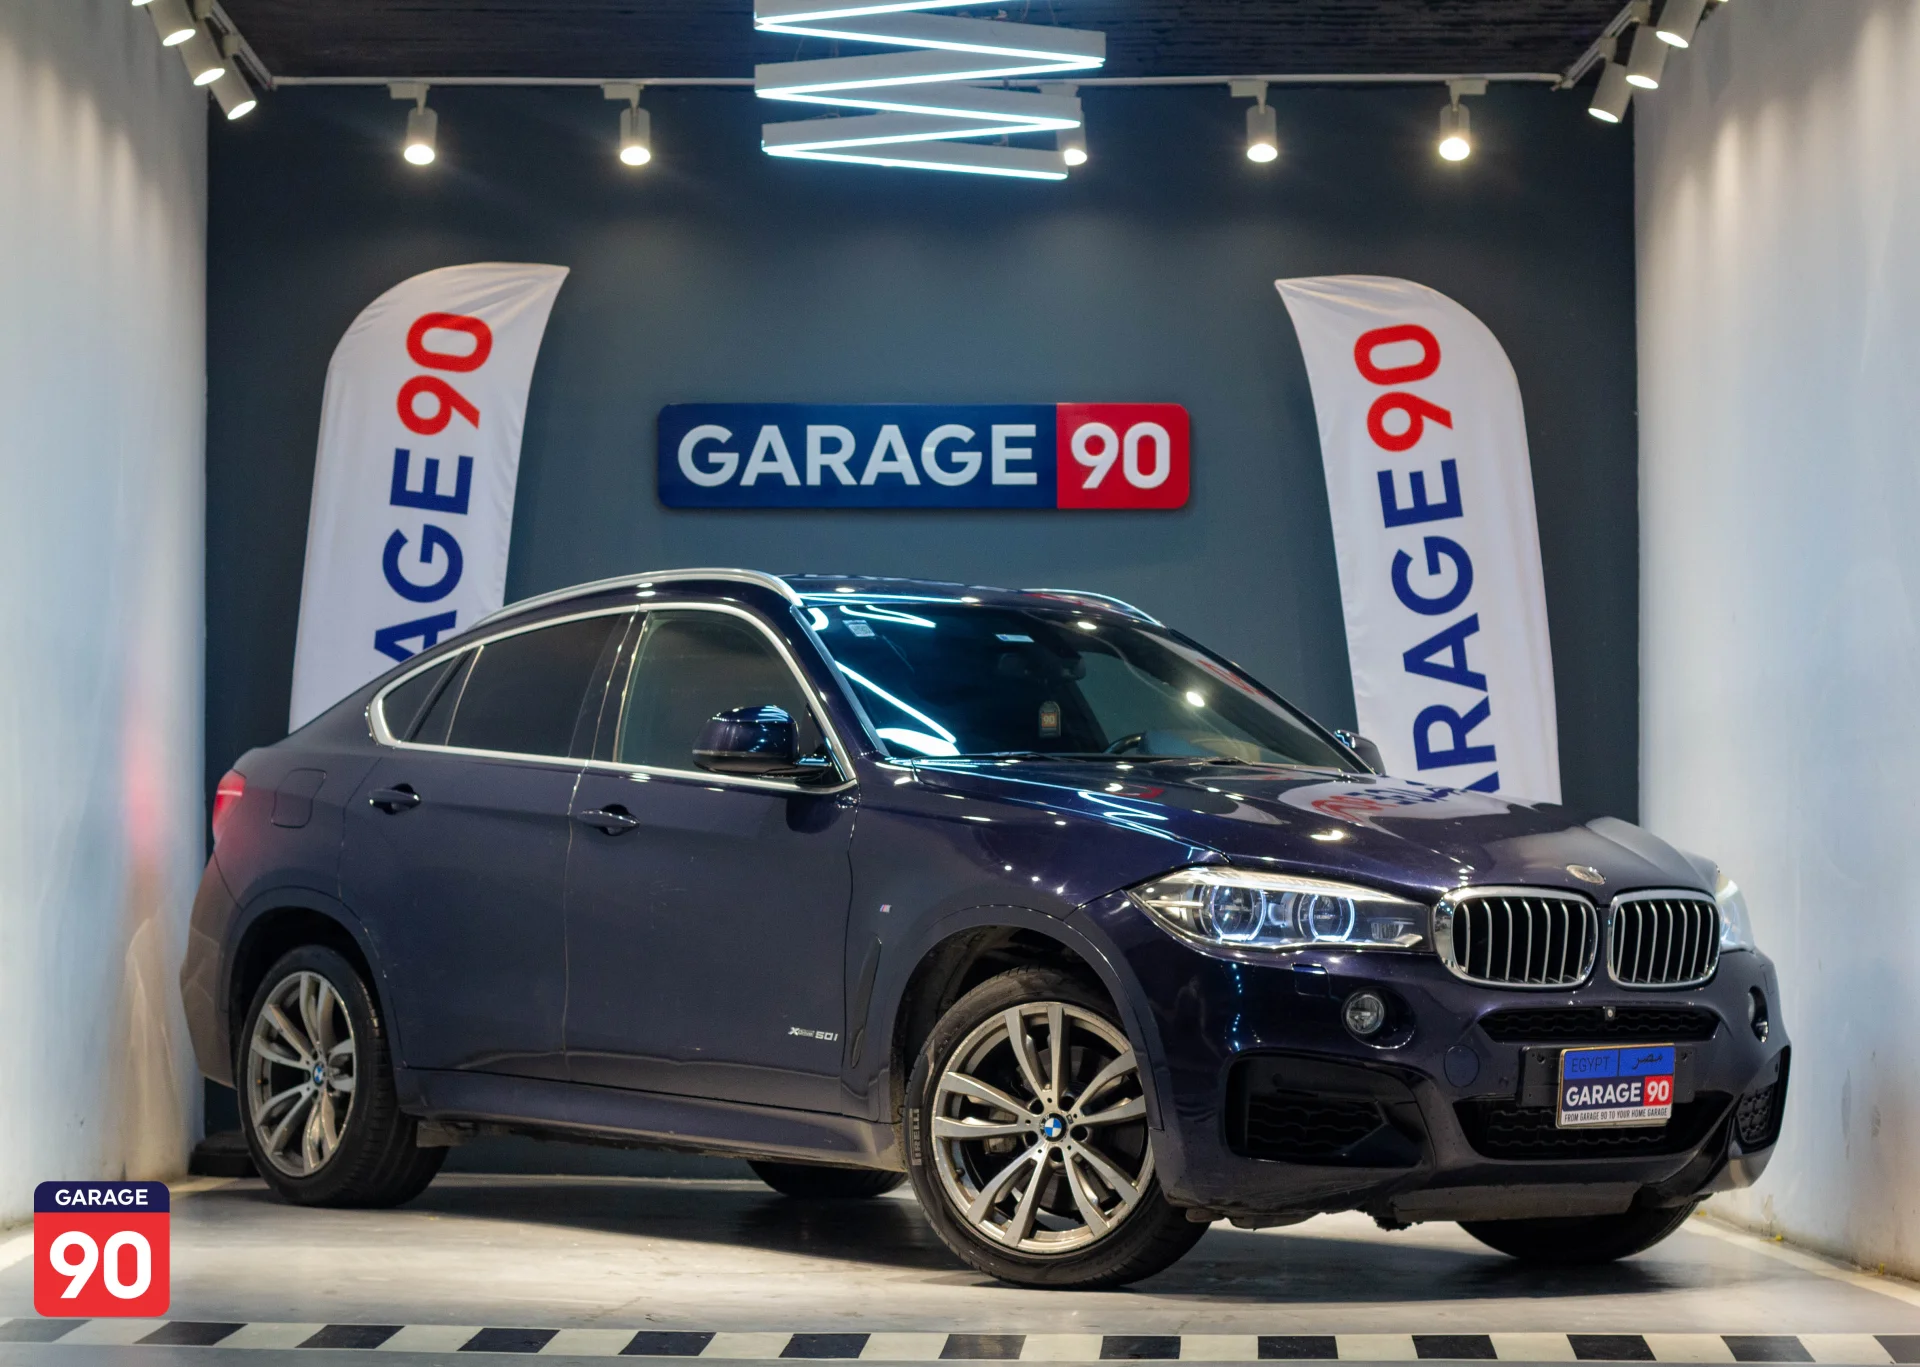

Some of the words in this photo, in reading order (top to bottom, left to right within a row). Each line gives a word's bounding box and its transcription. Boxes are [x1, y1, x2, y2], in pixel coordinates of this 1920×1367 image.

[677, 424, 1038, 487] GARAGE
[1071, 421, 1171, 490] 90
[1571, 1056, 1610, 1073] EGYPT
[1632, 1053, 1663, 1070] مصر
[1566, 1082, 1641, 1107] GARAGE
[1647, 1080, 1669, 1102] 90
[1564, 1113, 1579, 1122] FROM
[1580, 1111, 1599, 1121] GARAGE
[1600, 1110, 1608, 1120] 90
[1609, 1110, 1616, 1119] TO
[1617, 1109, 1630, 1119] YOUR
[1631, 1108, 1646, 1118] HOME
[1647, 1107, 1668, 1117] GARAGE
[909, 1108, 922, 1166] PIRELLI
